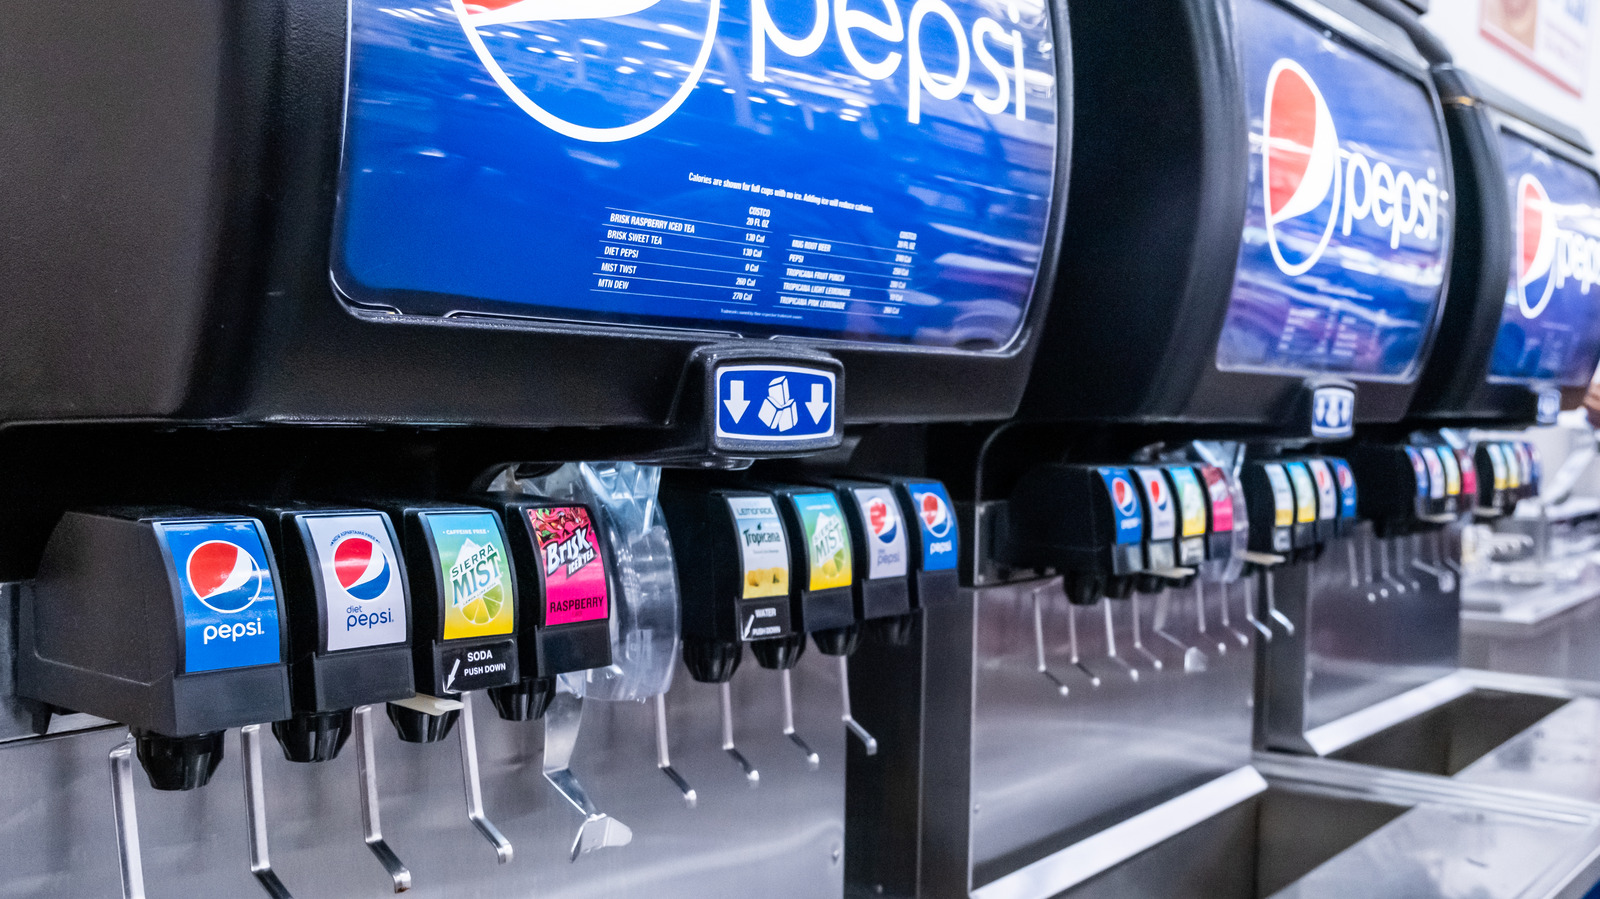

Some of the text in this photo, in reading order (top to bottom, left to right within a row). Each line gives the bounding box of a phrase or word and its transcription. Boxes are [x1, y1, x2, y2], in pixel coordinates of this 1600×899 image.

[752, 0, 1026, 124] pepsi
[688, 172, 712, 184] Calories
[712, 178, 723, 187] are
[723, 179, 742, 190] shown
[742, 182, 751, 192] for
[751, 183, 761, 193] full
[761, 187, 774, 197] cups
[1342, 153, 1438, 250] pepsi
[748, 206, 771, 218] COSTCO
[609, 213, 695, 234] BRISK RASPBERRY ICED TEA
[746, 217, 770, 228] 20 FL OZ
[607, 229, 662, 245] BRISK SWEET TEA
[755, 233, 766, 243] Cal
[604, 246, 639, 258] DIET PEPSI
[752, 249, 763, 258] Cal
[788, 253, 804, 263] PEPSI
[600, 262, 637, 275] MIST TWST
[745, 263, 760, 273] 0 Cal
[1556, 233, 1600, 295] pep
[597, 278, 630, 290] MTN DEW
[746, 278, 757, 287] Cal
[743, 292, 753, 301] Cal
[743, 528, 781, 547] Tropicana
[815, 522, 842, 563] MIST
[451, 544, 494, 578] SIERRA
[452, 551, 499, 605] MIST
[346, 605, 362, 614] diet
[550, 596, 604, 613] RASPBERRY
[346, 607, 392, 631] pepsi
[203, 617, 263, 645] pepsi
[467, 650, 493, 662] SODA
[464, 663, 506, 676] PUSH DOWN
